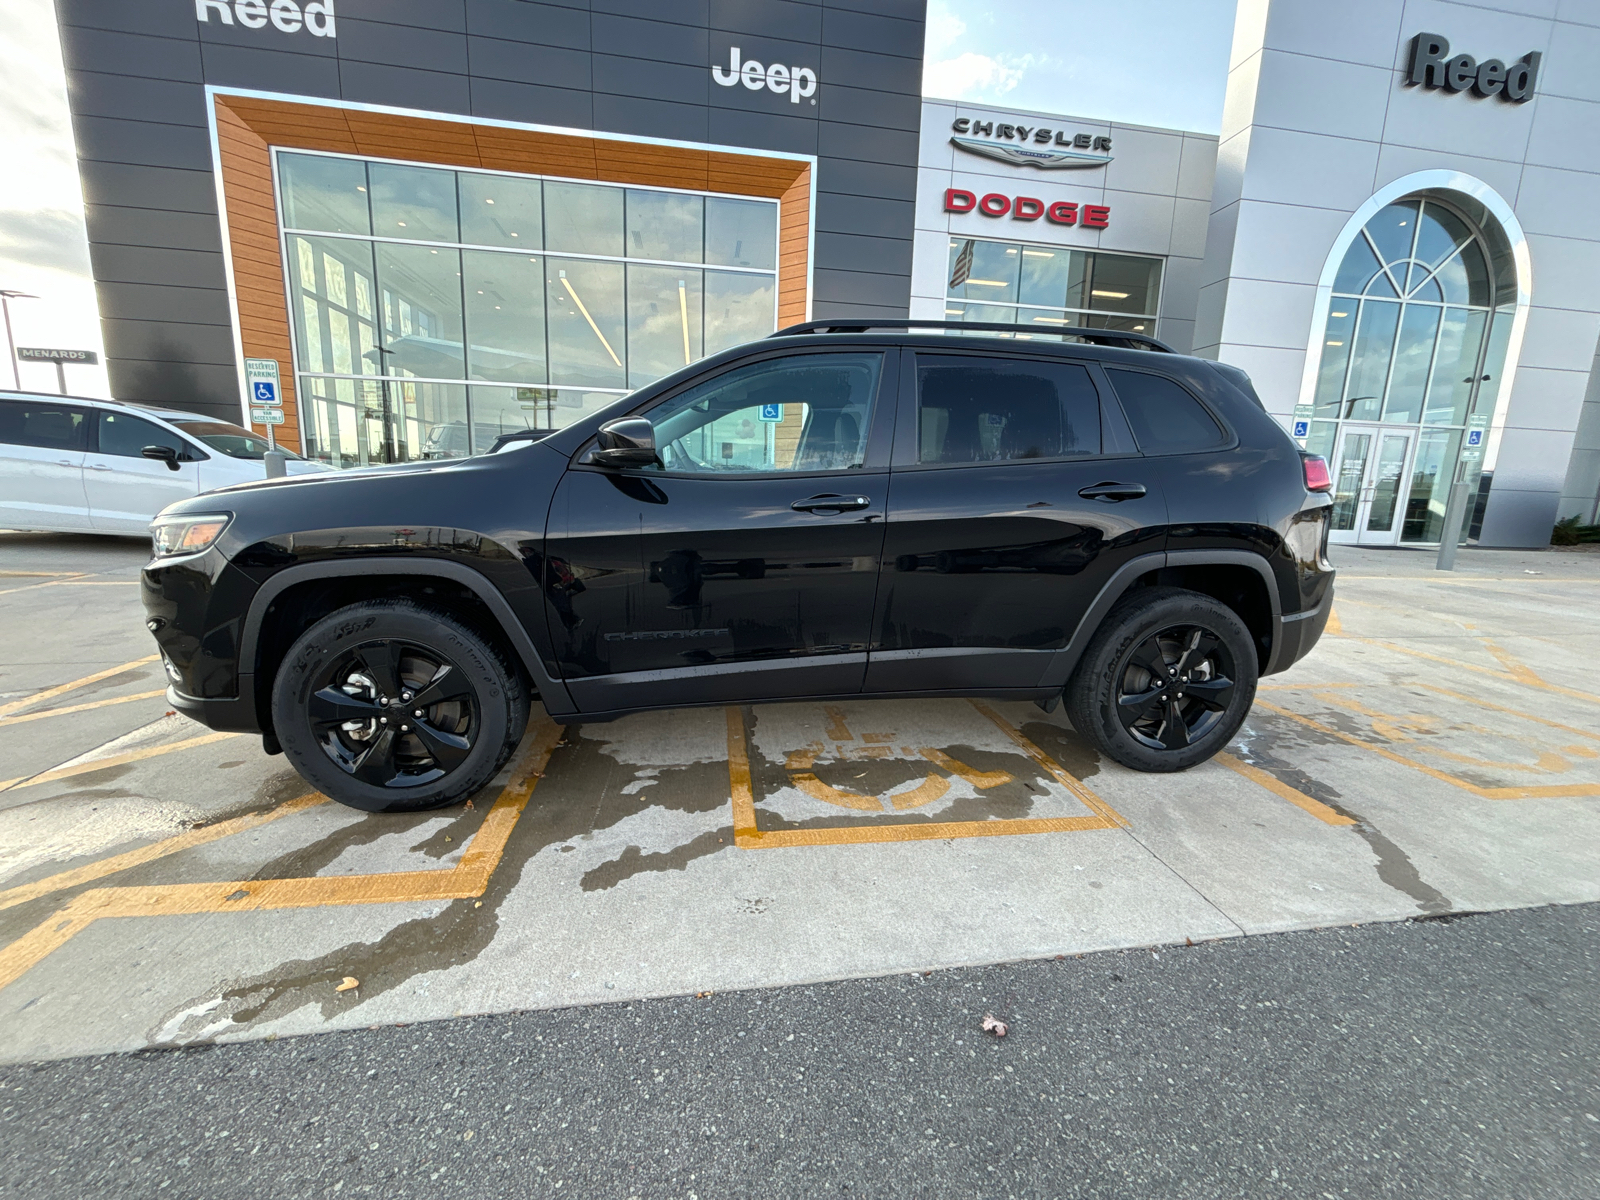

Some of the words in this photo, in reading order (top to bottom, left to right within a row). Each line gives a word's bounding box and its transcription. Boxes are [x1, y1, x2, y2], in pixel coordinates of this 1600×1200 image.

[712, 47, 817, 104] Jeep
[1406, 32, 1543, 103] Reed
[953, 118, 1113, 150] CHRYSLER
[944, 188, 1111, 230] DODGE
[22, 349, 87, 359] MENARDS
[248, 362, 275, 371] RESERVED
[603, 628, 729, 641] CHEROKEE
